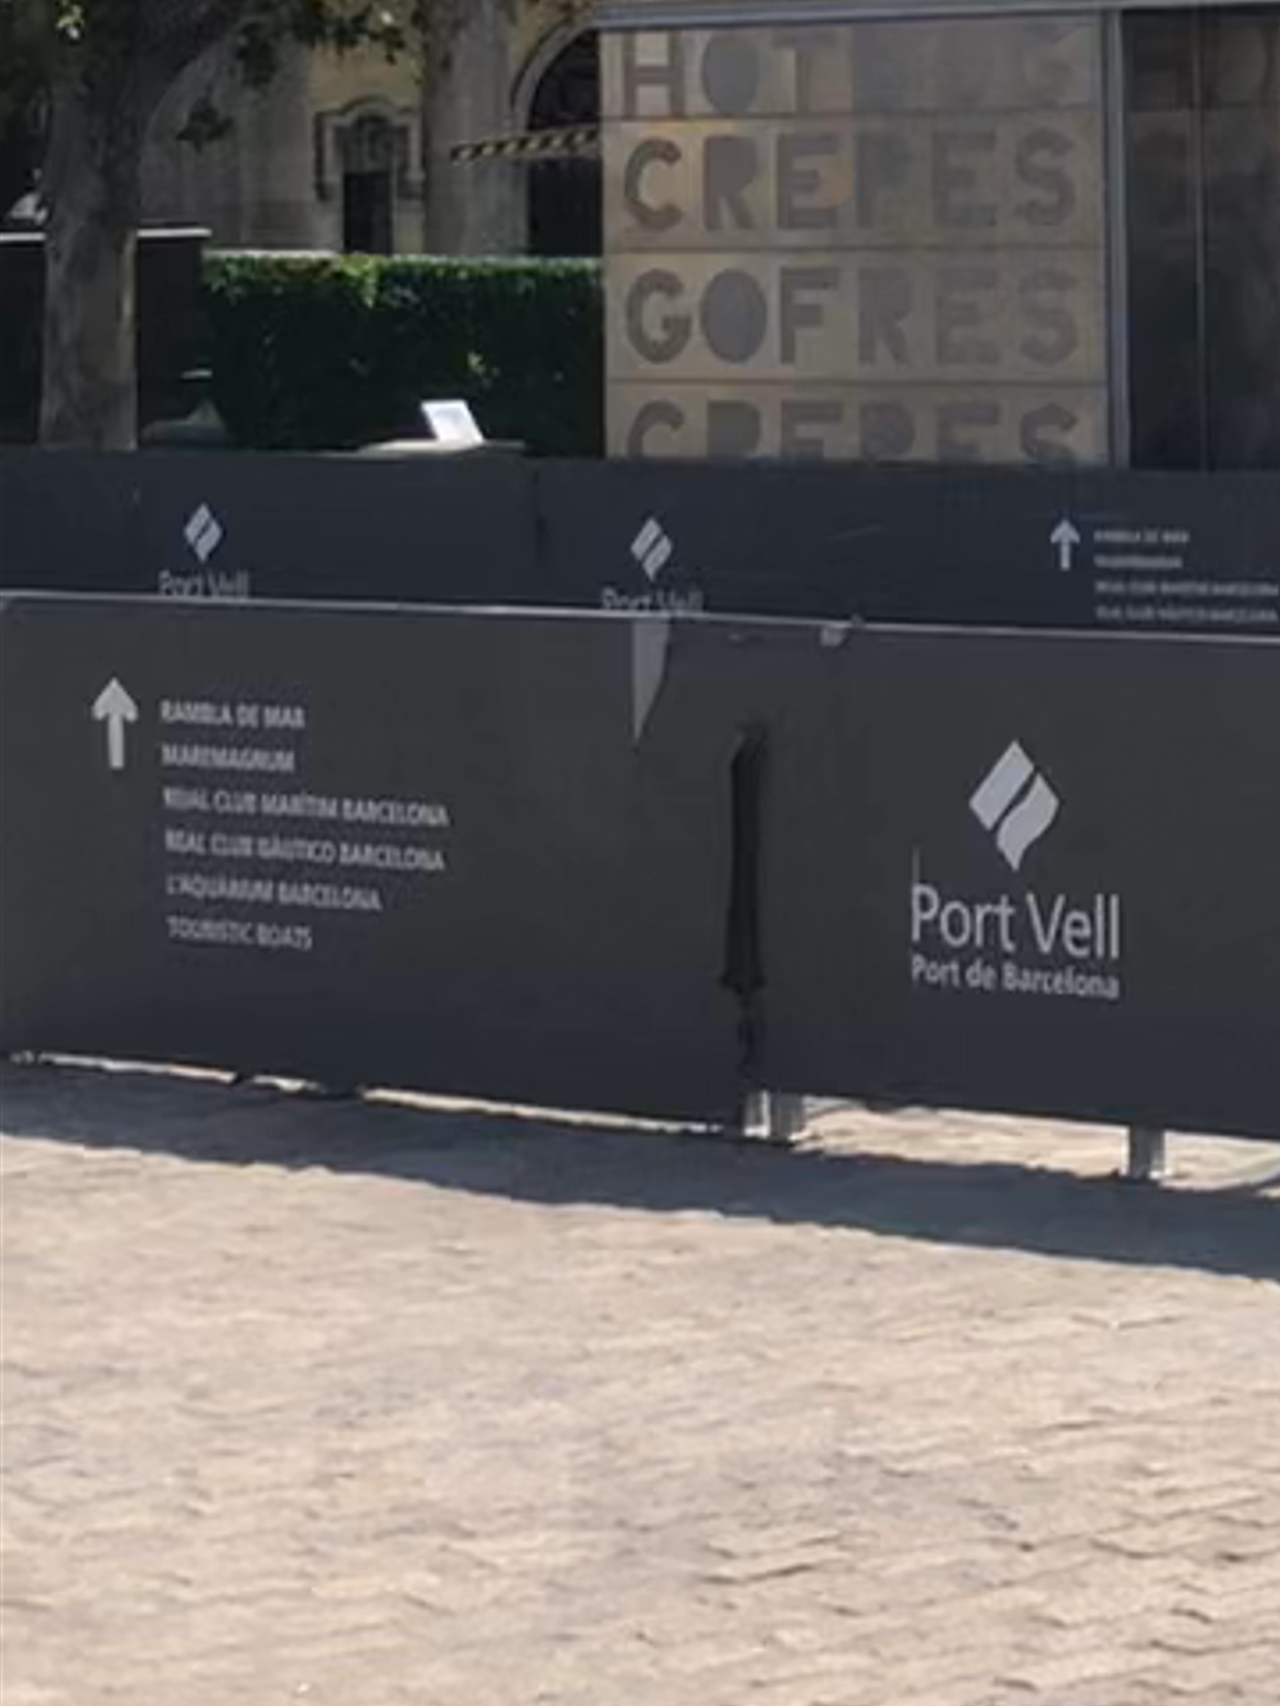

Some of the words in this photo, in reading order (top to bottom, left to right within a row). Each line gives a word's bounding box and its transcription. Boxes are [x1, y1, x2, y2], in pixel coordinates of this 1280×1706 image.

[624, 128, 1077, 230] CREPES
[625, 268, 1079, 364] GOFRES
[160, 700, 232, 725] RAMBLA
[237, 704, 259, 727] DE
[263, 706, 305, 729] MAR
[213, 790, 256, 814] CLUB
[343, 798, 449, 825] BARCELONA
[340, 843, 446, 871] BARCELONA
[278, 882, 382, 911] BARCELONA
[911, 884, 1015, 953] Port
[1026, 892, 1120, 959] Vell
[912, 954, 960, 987] Port
[965, 958, 997, 990] de
[1002, 961, 1120, 999] Barcelona
